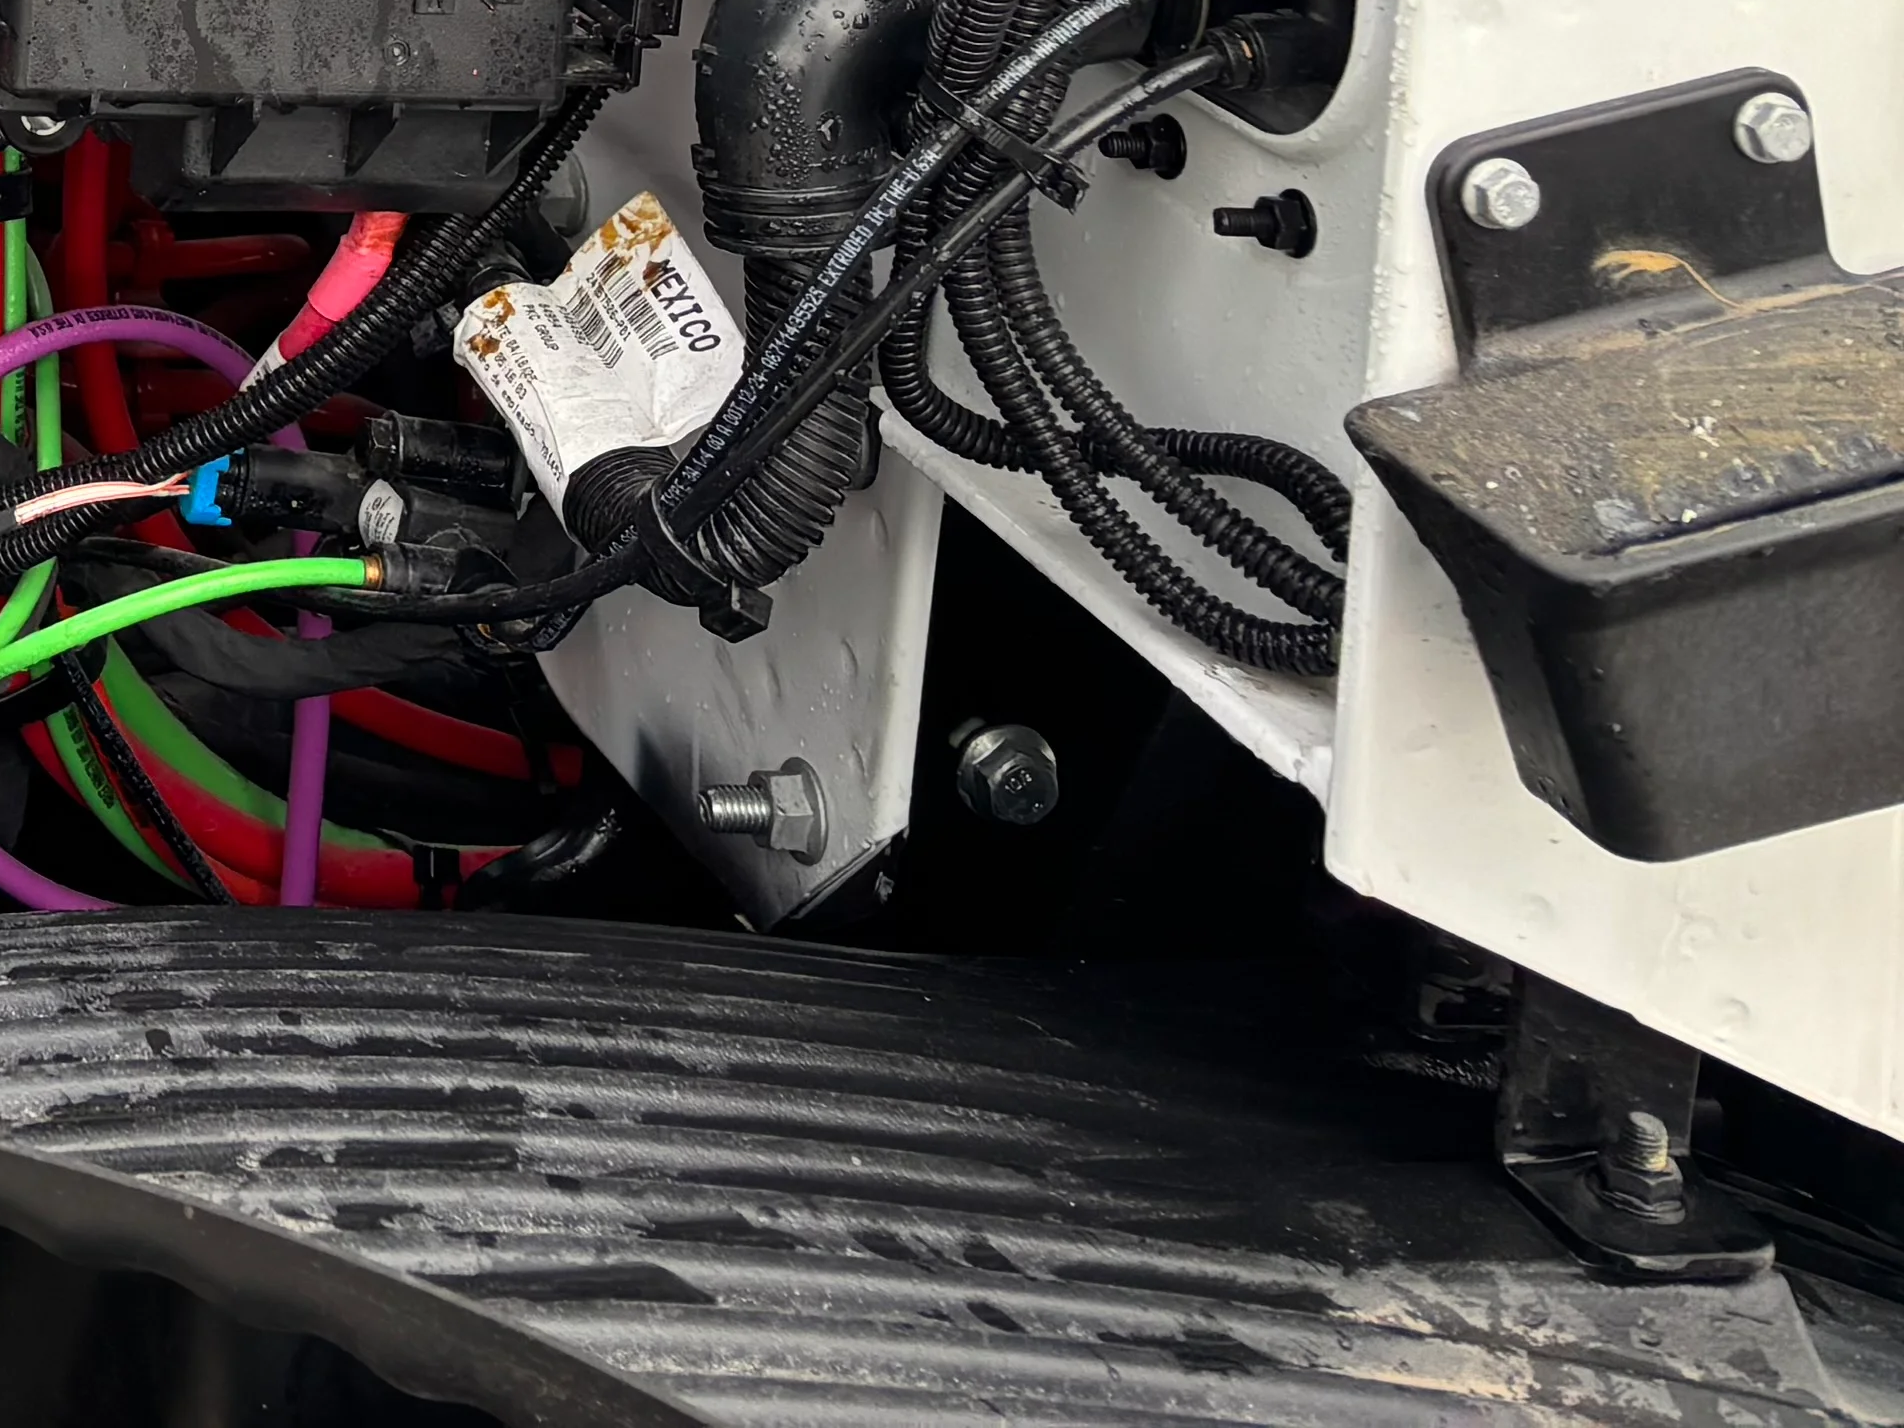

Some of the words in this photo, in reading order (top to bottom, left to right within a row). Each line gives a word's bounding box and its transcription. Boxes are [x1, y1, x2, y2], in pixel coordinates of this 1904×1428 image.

[818, 222, 874, 290] EXTRUDED
[882, 177, 912, 210] THE
[533, 322, 558, 353] GROUP
[642, 258, 722, 360] MEXICO
